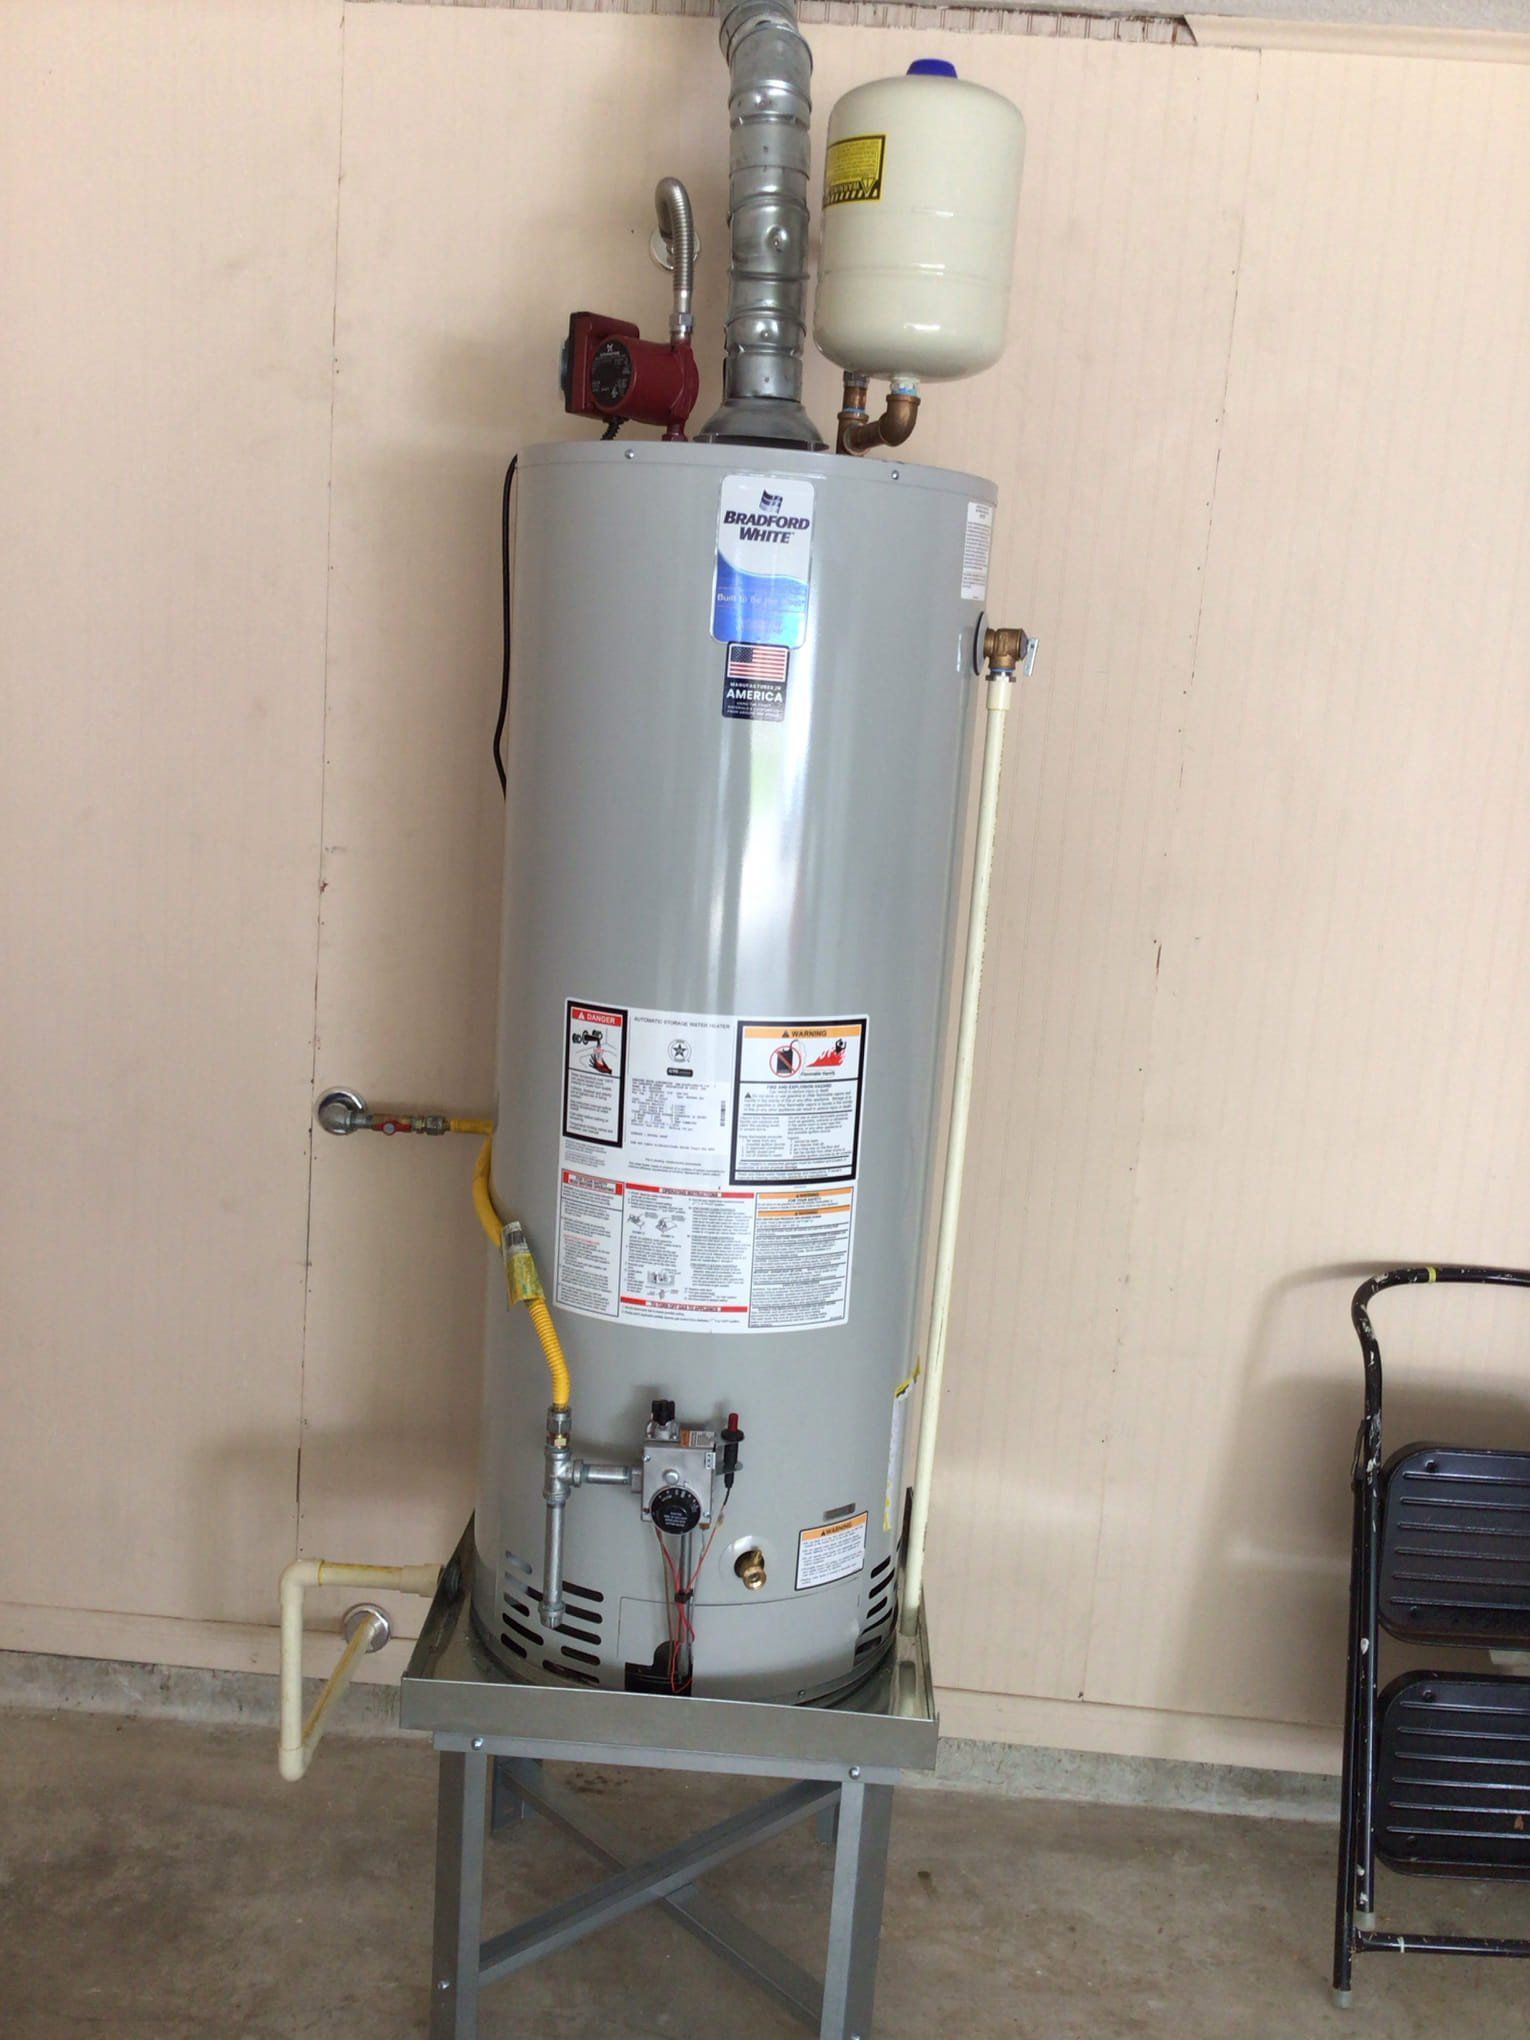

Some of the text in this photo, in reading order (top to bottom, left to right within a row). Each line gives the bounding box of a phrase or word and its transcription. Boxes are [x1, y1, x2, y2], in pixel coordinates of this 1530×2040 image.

[723, 510, 810, 530] BRADFORD
[739, 526, 792, 544] WHITE
[726, 688, 783, 703] AMERICA
[586, 1013, 616, 1024] DANGER
[791, 1030, 828, 1038] WARNING
